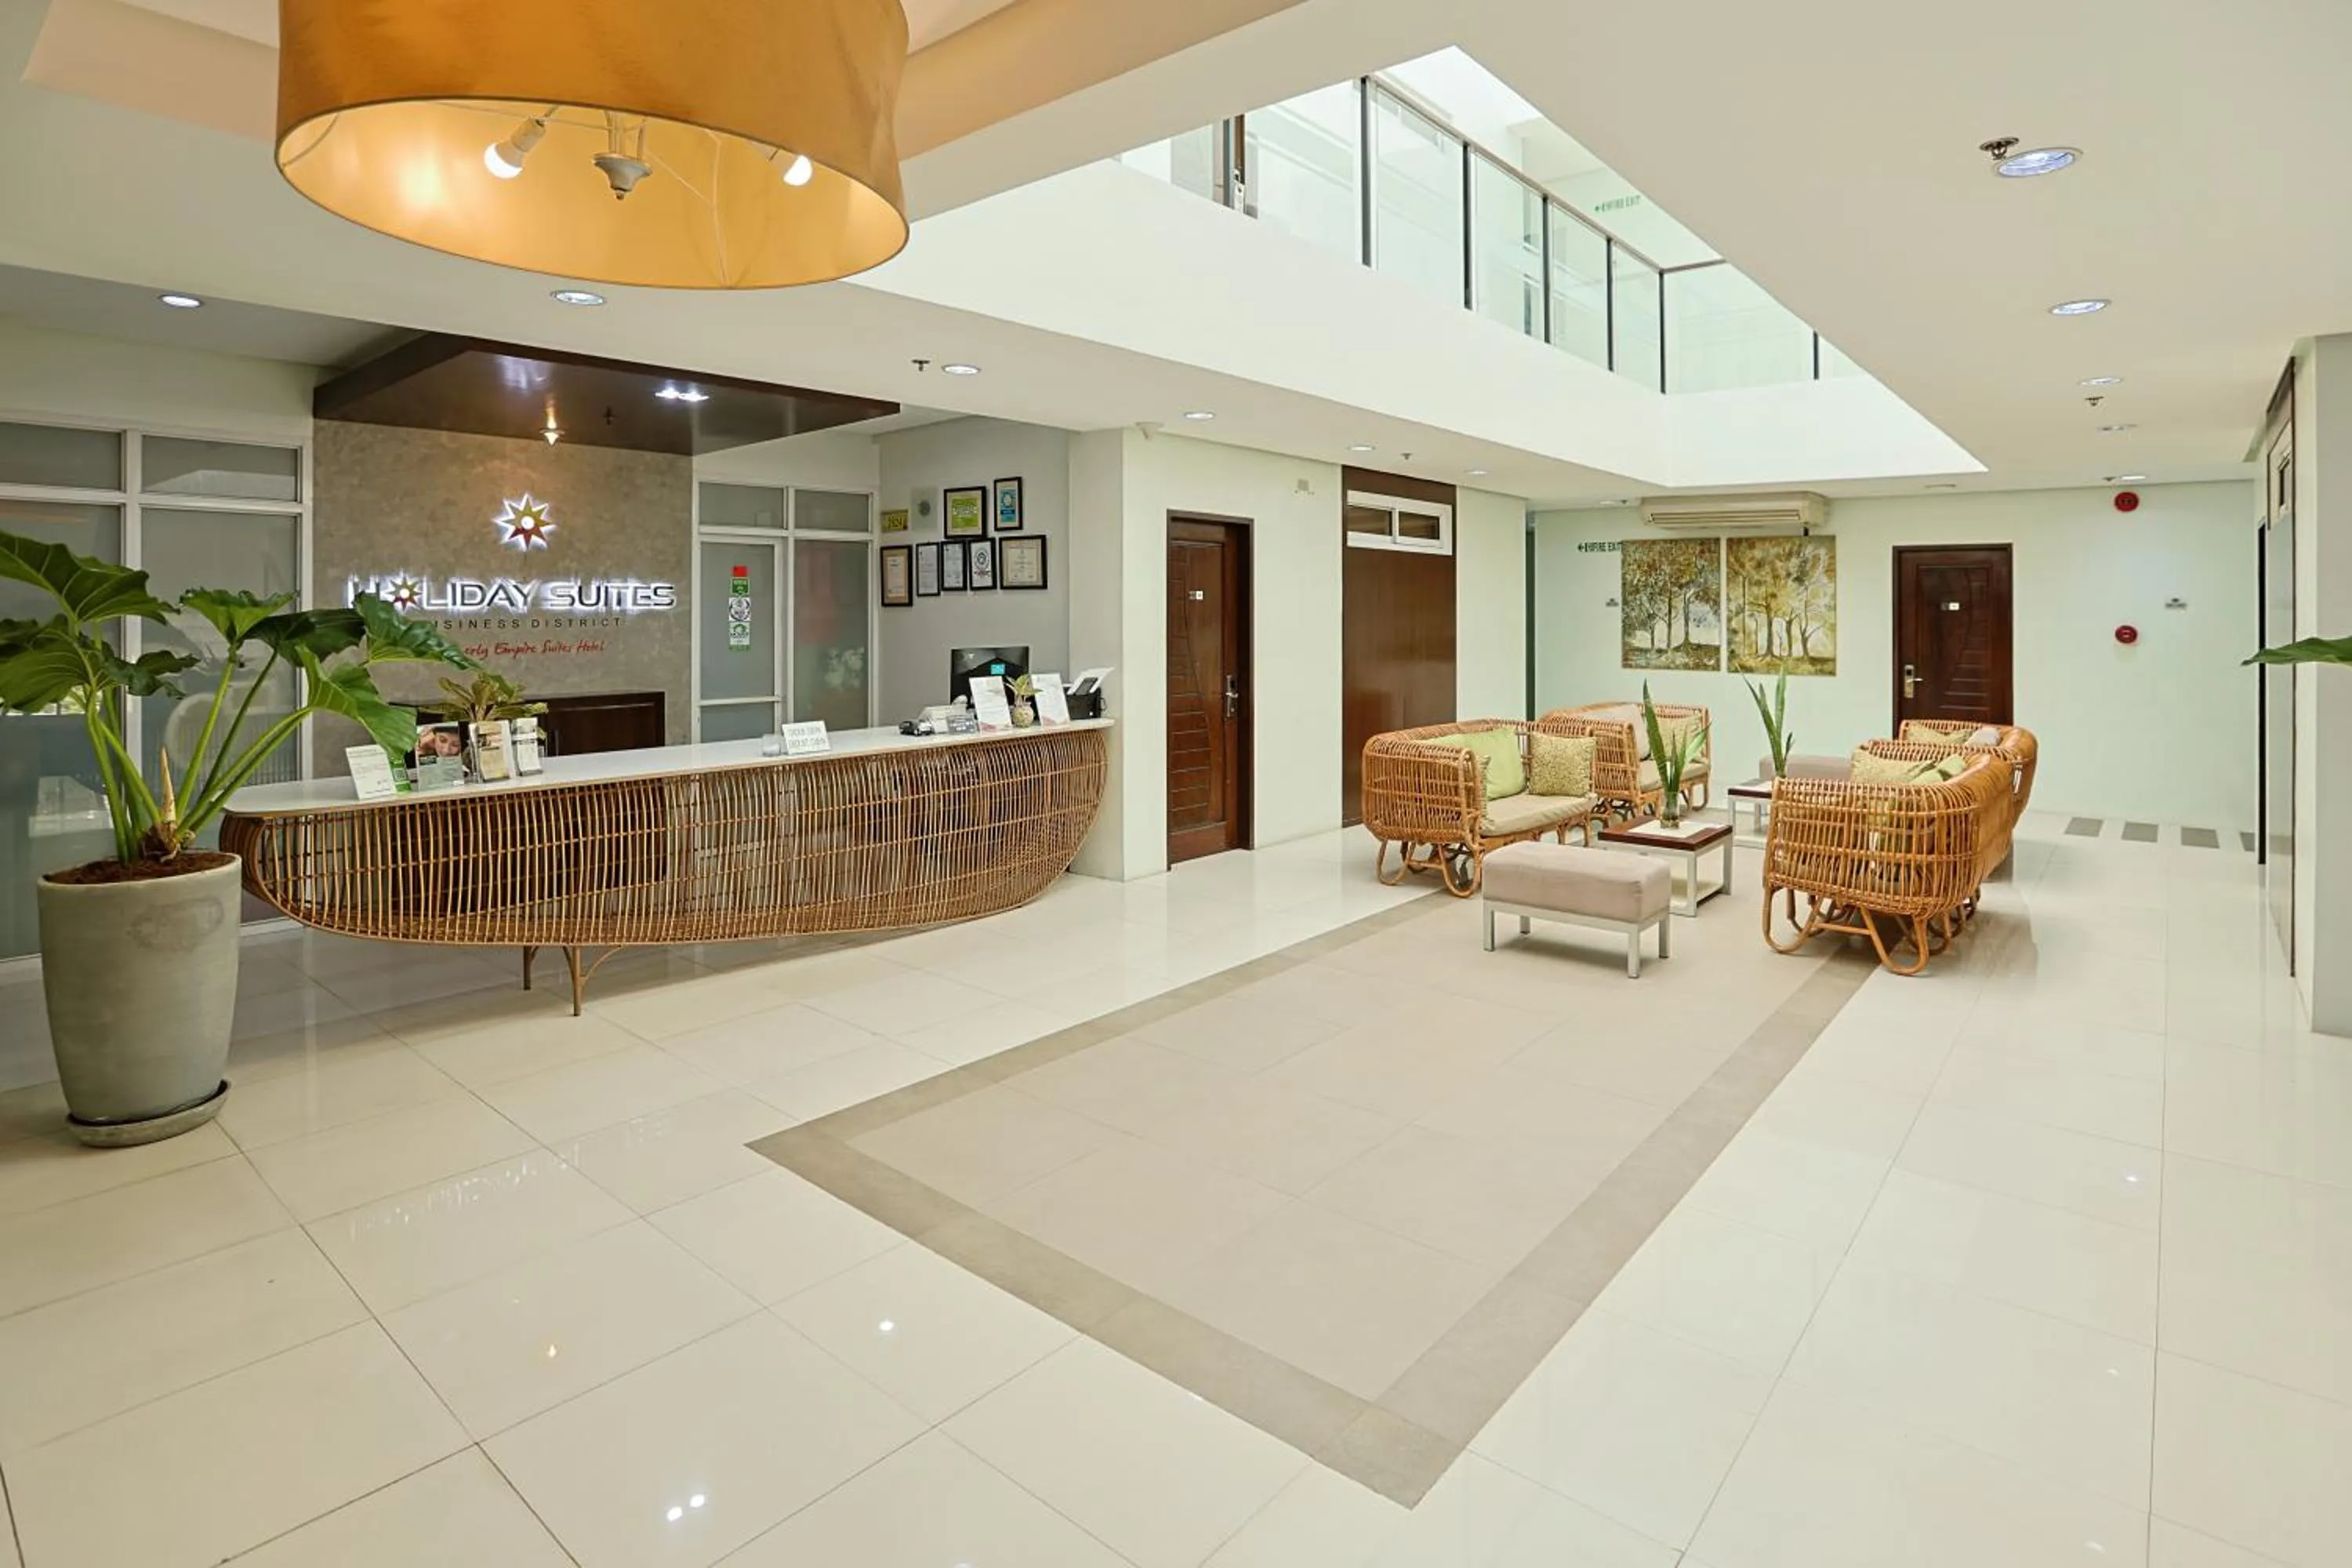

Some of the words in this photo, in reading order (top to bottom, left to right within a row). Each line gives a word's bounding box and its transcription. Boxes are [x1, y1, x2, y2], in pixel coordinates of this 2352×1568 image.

[1608, 542, 1623, 552] EXIT
[546, 581, 677, 609] SUITES
[531, 617, 621, 629] DISTRICT
[494, 641, 537, 659] Empire
[542, 639, 572, 654] Suites
[576, 639, 605, 653] Hotel
